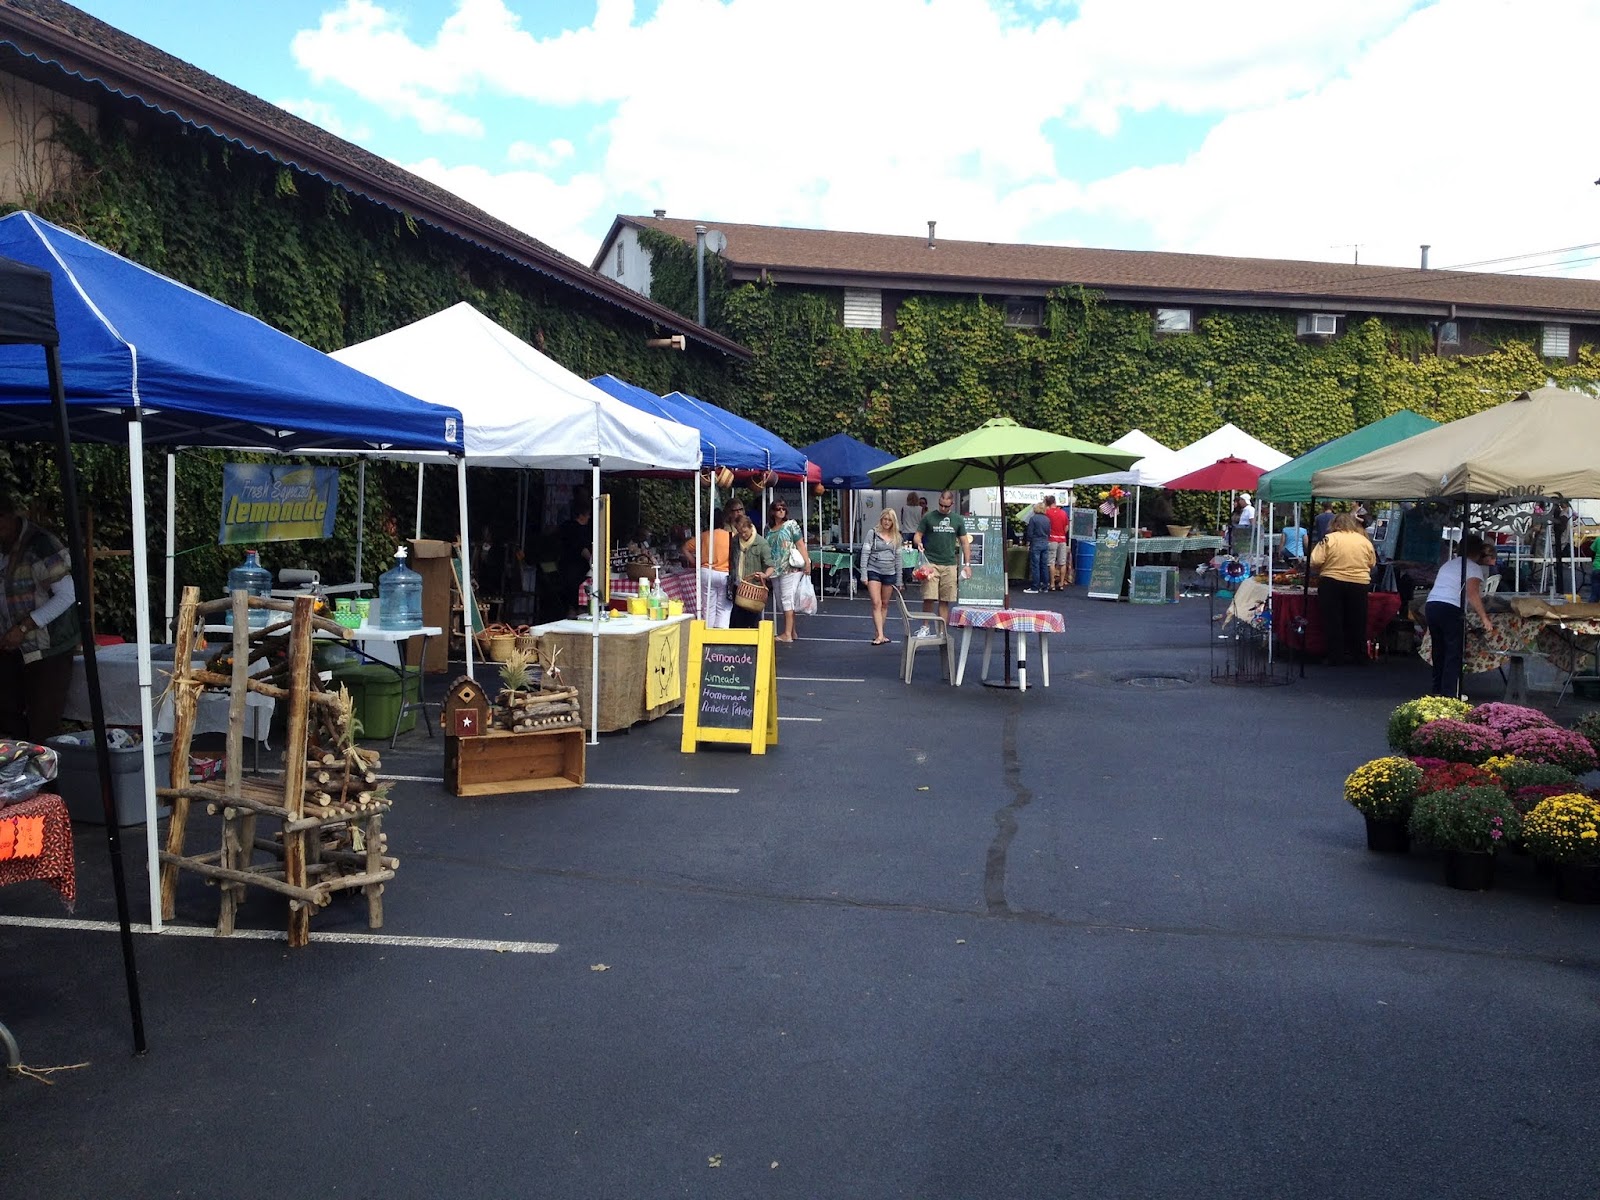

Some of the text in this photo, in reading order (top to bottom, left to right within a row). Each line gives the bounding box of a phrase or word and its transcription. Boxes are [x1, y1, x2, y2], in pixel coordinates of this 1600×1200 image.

[241, 480, 269, 498] Fresh
[1497, 484, 1546, 497] DODGE
[705, 647, 753, 664] Lemonade
[704, 671, 740, 683] Limeade
[702, 688, 747, 701] Homemade
